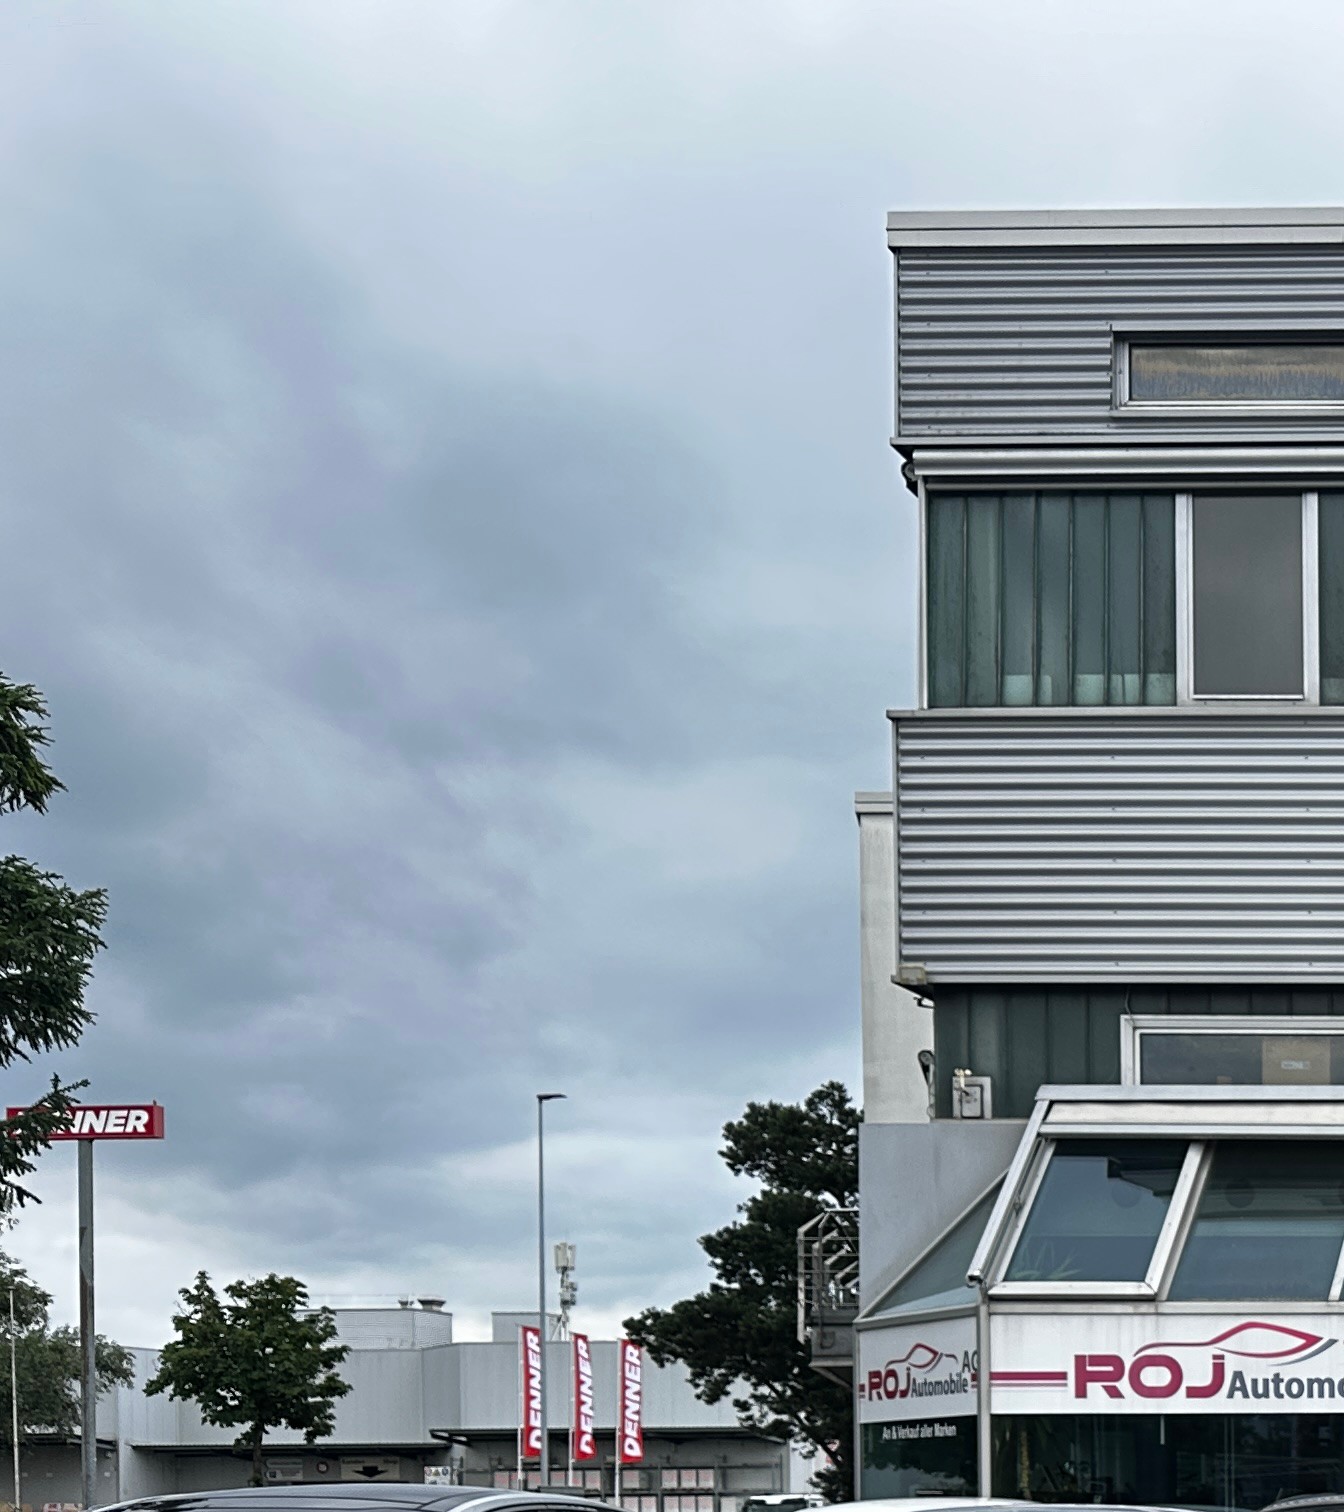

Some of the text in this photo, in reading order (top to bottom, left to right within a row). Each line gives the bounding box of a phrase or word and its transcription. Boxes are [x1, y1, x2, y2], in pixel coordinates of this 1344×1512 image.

[868, 1367, 911, 1401] ROJ
[911, 1373, 968, 1398] Automobile
[1074, 1354, 1225, 1399] ROJ
[624, 1345, 643, 1457] DENNER
[882, 1426, 891, 1439] An
[898, 1423, 919, 1438] Verkauf
[934, 1423, 957, 1436] Marken
